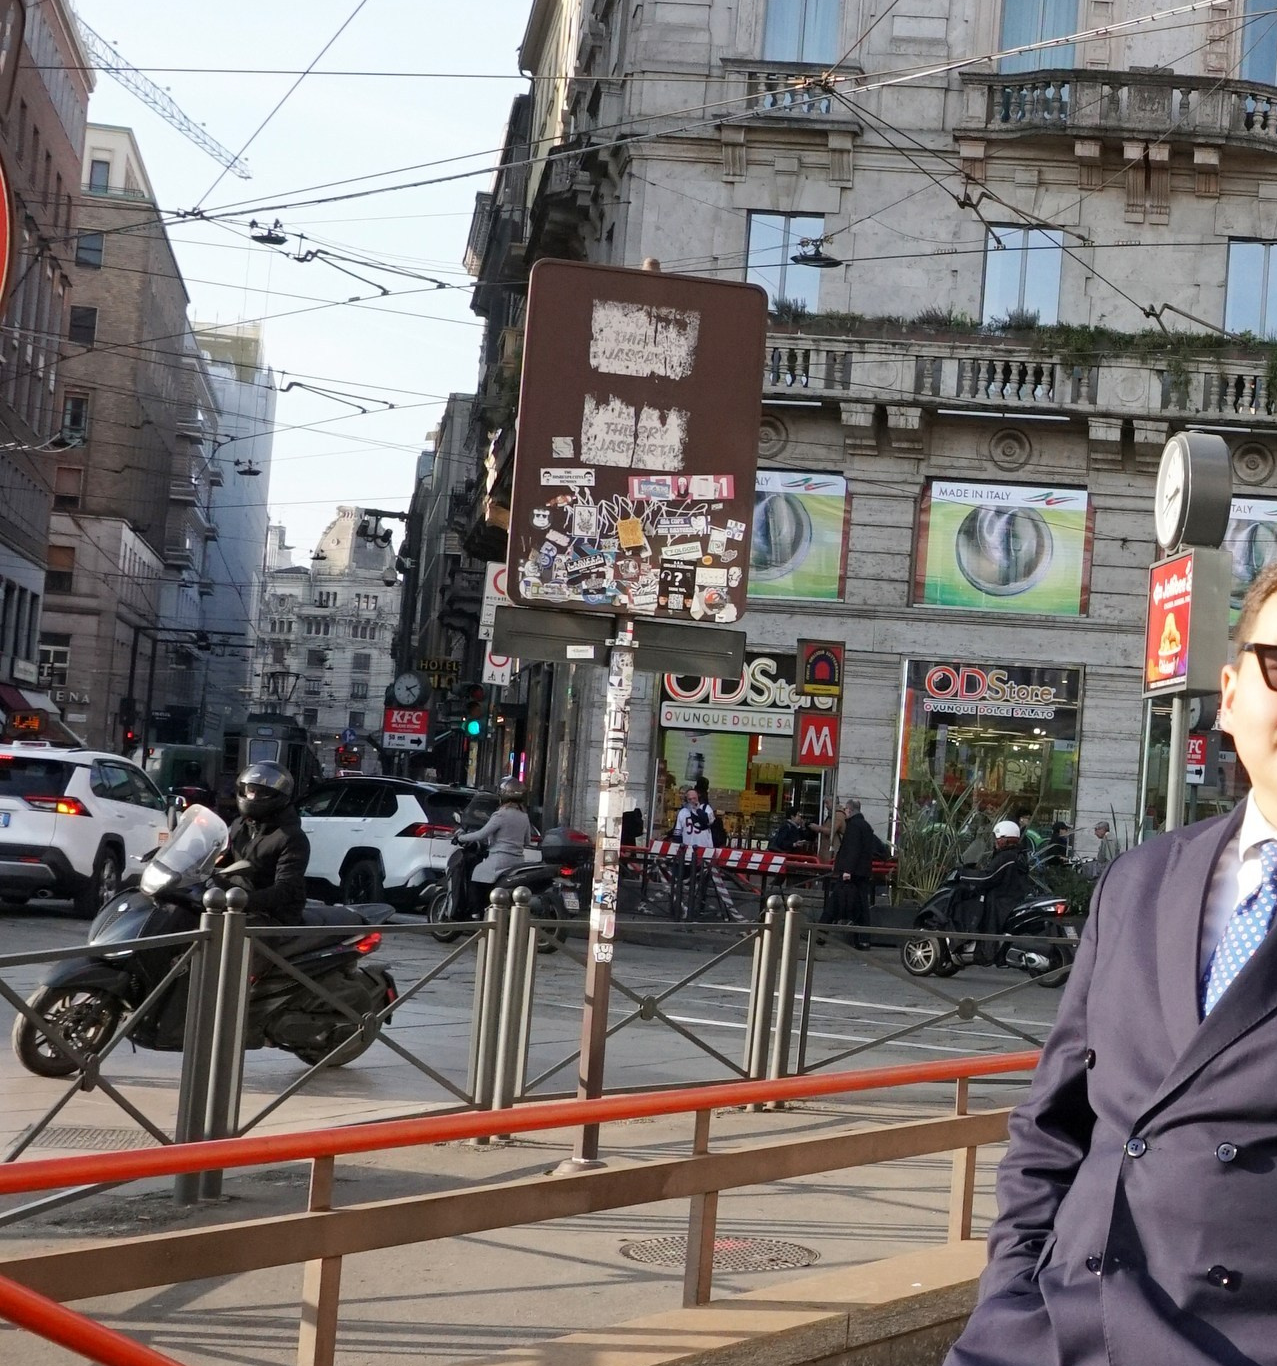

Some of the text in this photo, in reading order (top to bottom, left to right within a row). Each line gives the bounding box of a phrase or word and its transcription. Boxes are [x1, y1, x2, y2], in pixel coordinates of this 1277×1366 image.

[755, 477, 771, 485] ALY
[939, 487, 1011, 500] MADE IN ITALY
[1231, 504, 1254, 514] TALY
[421, 660, 458, 671] HOTEL
[925, 666, 1053, 703] ODStore
[924, 702, 1054, 719] OVUNQUE DOLCE SALATO
[391, 711, 422, 724] KFC
[665, 711, 727, 724] OVUNQUE
[732, 715, 772, 728] DOLCE
[801, 726, 833, 757] M
